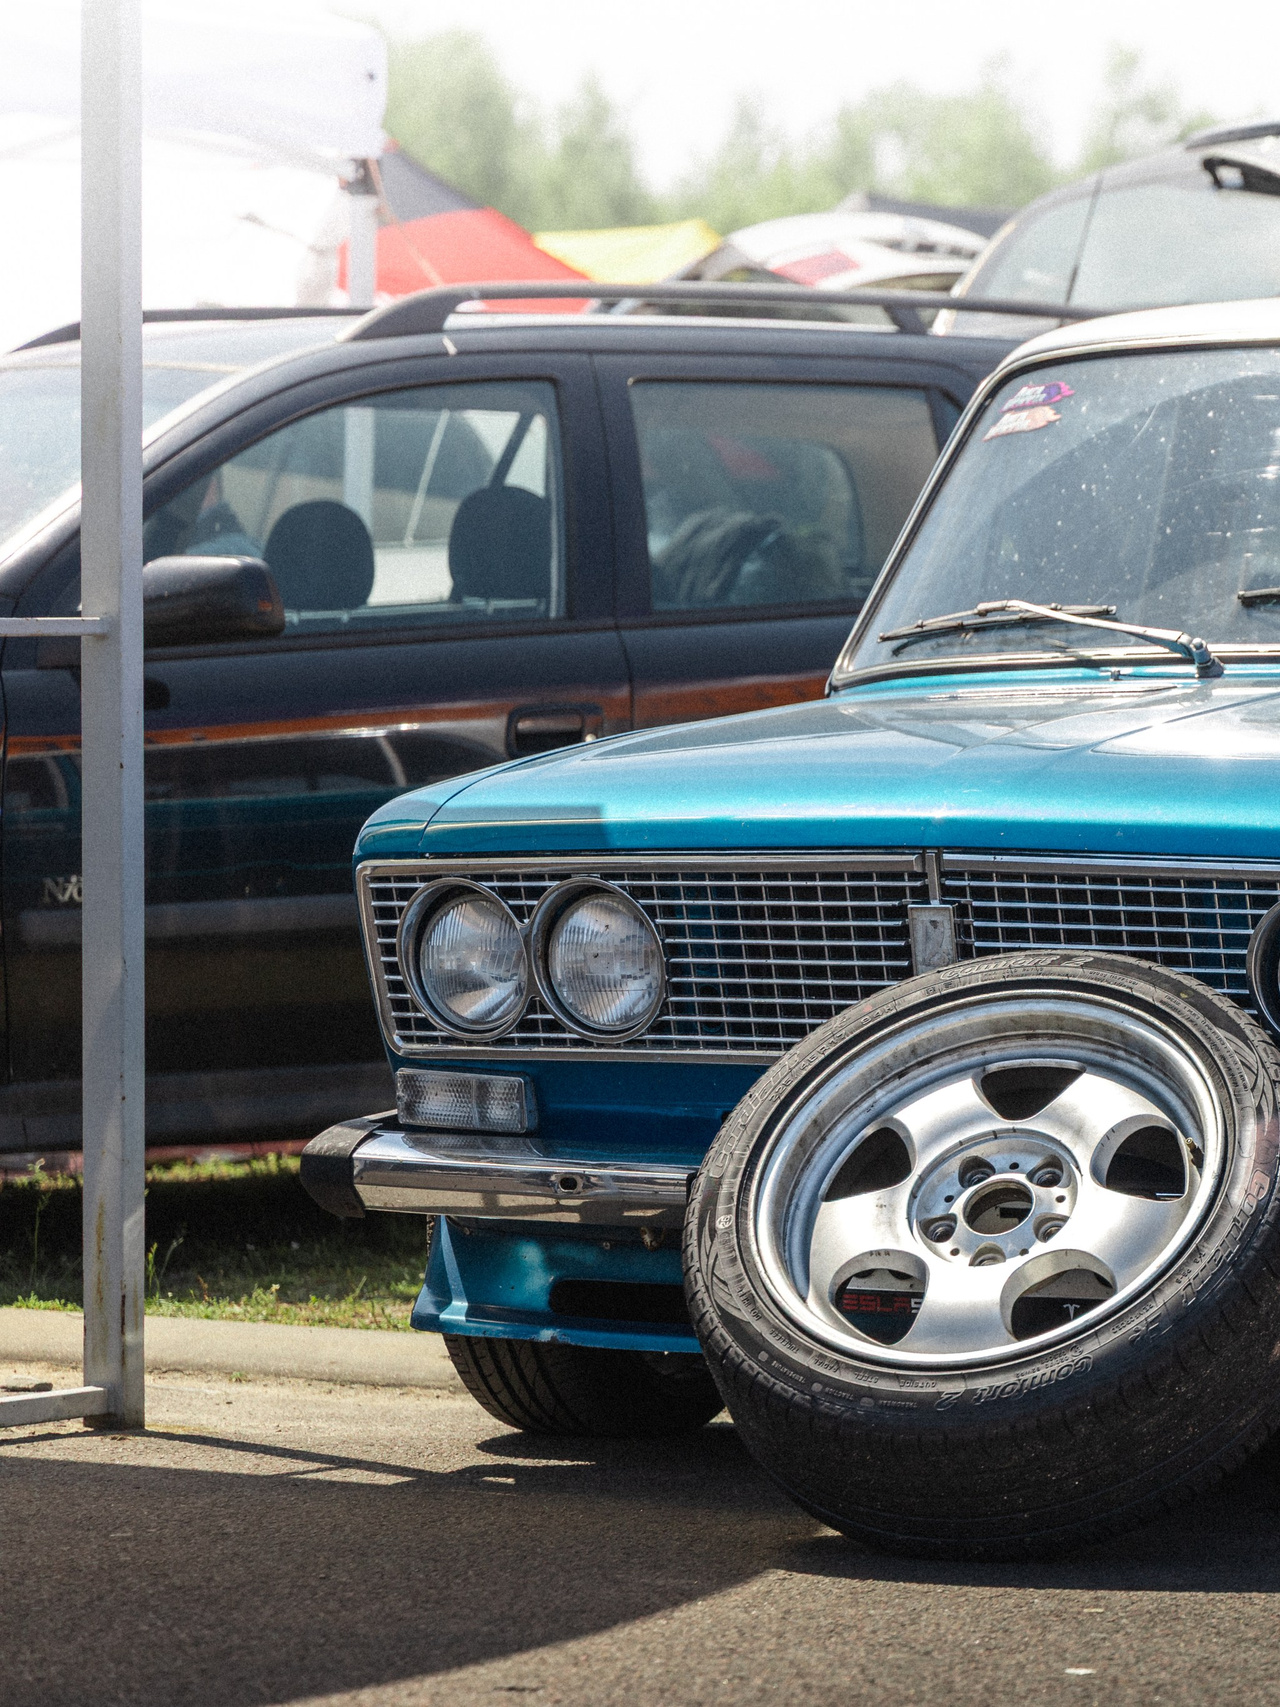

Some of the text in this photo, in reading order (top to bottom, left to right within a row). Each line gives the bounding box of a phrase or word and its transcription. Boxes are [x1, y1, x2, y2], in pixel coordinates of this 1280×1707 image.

[940, 955, 1061, 981] Comfort
[1062, 955, 1094, 968] 2
[709, 1050, 801, 1179] Cordiant
[1181, 1168, 1271, 1307] Cordiant
[812, 1357, 841, 1373] RADIAL
[852, 1371, 880, 1384] STEEL
[898, 1378, 938, 1389] OUTSIDE
[971, 1353, 1094, 1405] Comfort
[934, 1389, 966, 1411] 2
